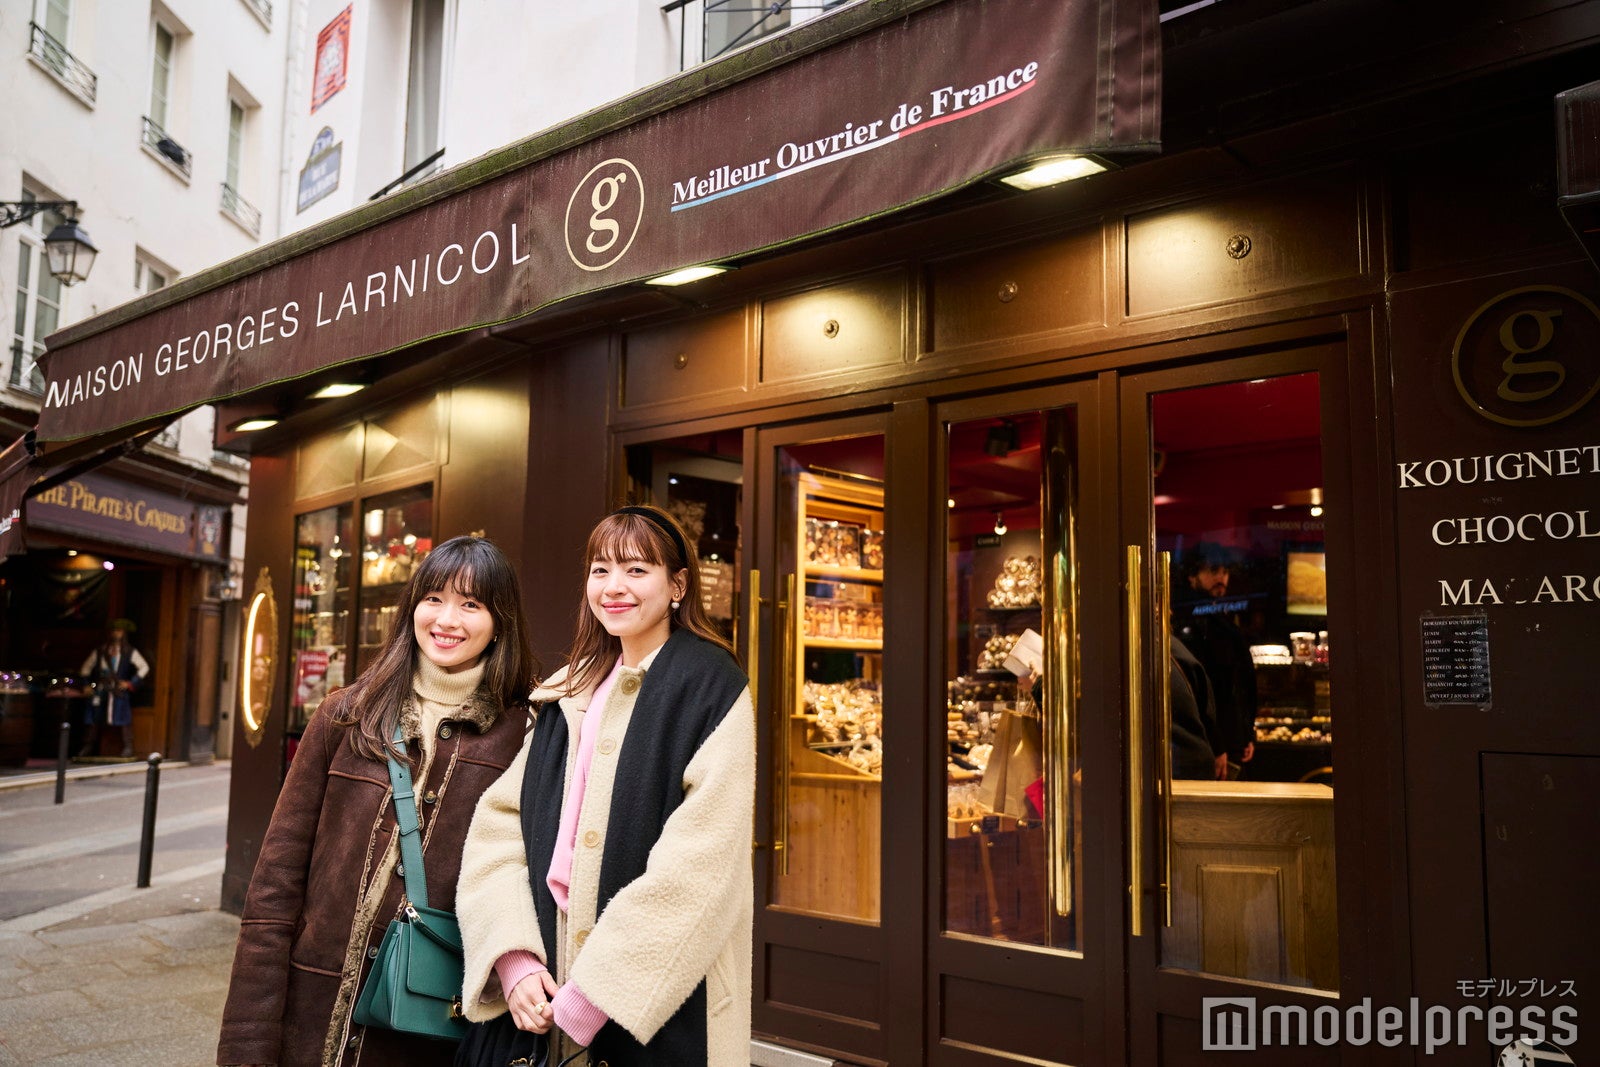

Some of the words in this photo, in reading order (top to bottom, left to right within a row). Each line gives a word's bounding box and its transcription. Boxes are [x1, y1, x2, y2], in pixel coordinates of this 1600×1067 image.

[671, 156, 771, 204] Meilleur
[776, 123, 883, 169] Ouvrier
[889, 103, 922, 132] de
[929, 61, 1039, 118] France
[44, 353, 143, 408] MAISON
[155, 301, 299, 376] GEORGES
[316, 223, 531, 327] LARNICOL
[1432, 510, 1600, 546] CHOCOL
